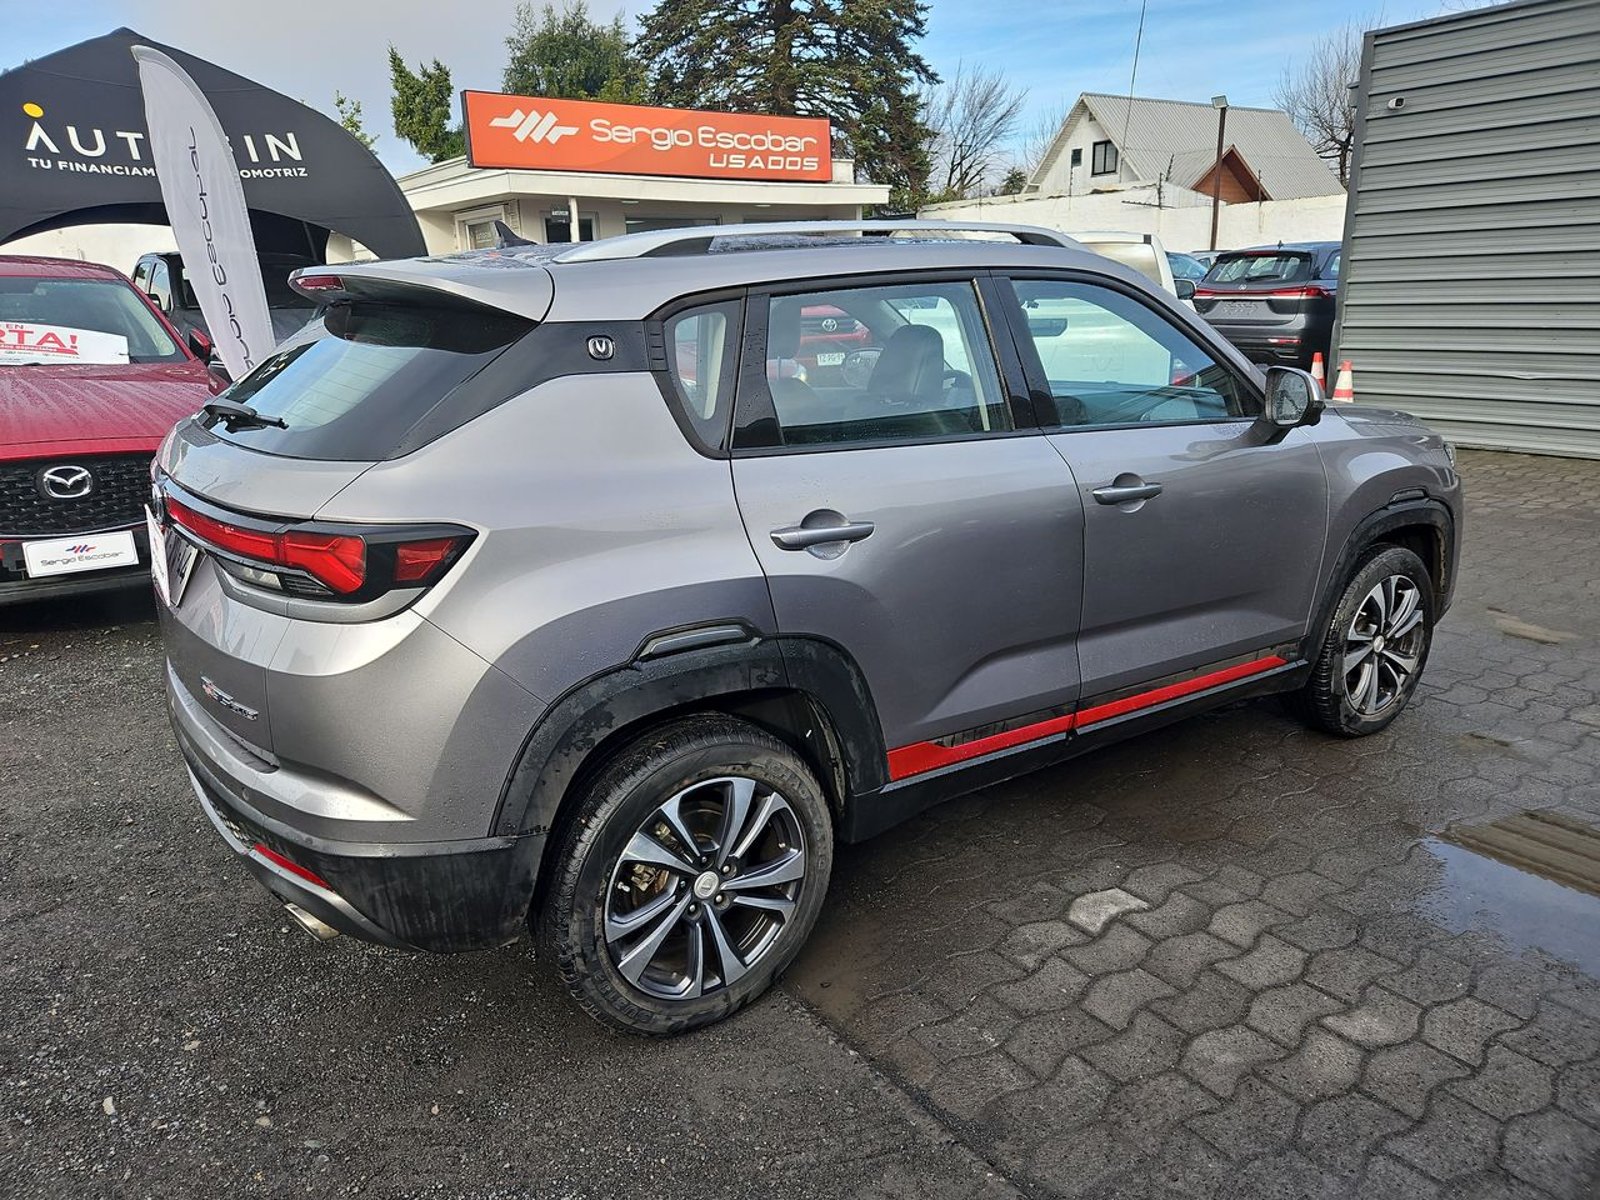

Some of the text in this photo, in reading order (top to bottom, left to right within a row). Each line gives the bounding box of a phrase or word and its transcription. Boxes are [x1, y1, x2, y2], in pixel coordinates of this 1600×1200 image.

[25, 119, 303, 162] AUTIN
[589, 118, 817, 152] Sergio Escobar
[28, 157, 309, 179] TU FINANCIAM OMOTRIZ
[709, 153, 819, 171] USADOS
[78, 551, 124, 561] Escobar
